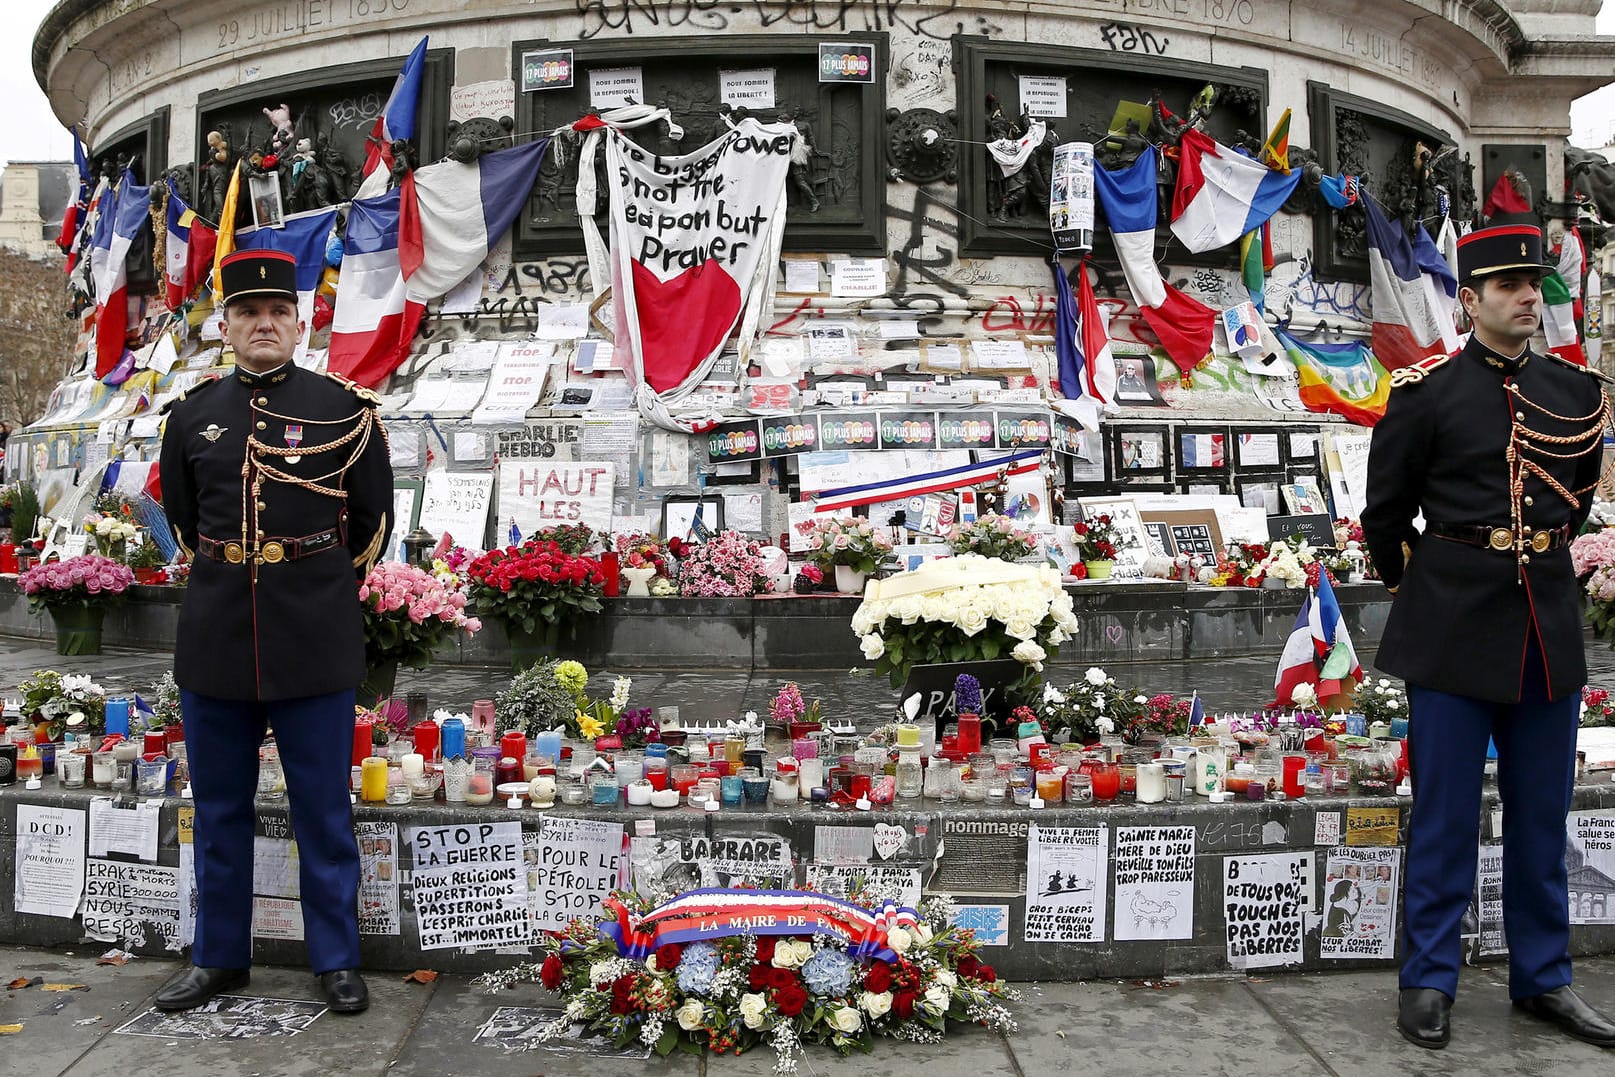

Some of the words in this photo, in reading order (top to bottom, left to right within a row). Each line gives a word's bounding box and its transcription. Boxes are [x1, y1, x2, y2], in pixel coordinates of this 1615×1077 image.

[217, 20, 239, 49] 29
[248, 0, 334, 40] JUILLET
[1341, 24, 1355, 52] 14
[1361, 32, 1418, 75] JUILLET
[526, 69, 533, 80] 17
[534, 67, 548, 78] PLUS
[549, 63, 569, 76] JAMAIS
[822, 60, 830, 70] 17
[831, 59, 847, 71] PLUS
[848, 59, 868, 71] JAMAIS
[744, 79, 769, 87] SOMMES
[633, 176, 687, 204] not
[689, 173, 726, 202] the
[624, 203, 711, 239] eapon
[716, 199, 768, 239] but
[511, 348, 541, 357] STOP
[712, 365, 732, 374] ARLIE
[503, 376, 533, 385] STOP
[499, 424, 580, 444] CHARLIE
[765, 434, 774, 445] 17
[775, 432, 791, 444] PLUS
[792, 428, 816, 442] JAMAIS
[823, 427, 832, 438] 17
[833, 427, 850, 439] PLUS
[851, 426, 875, 438] JAMAIS
[882, 426, 891, 437] 17
[892, 426, 909, 438] PLUS
[910, 425, 933, 438] JAMAIS
[941, 426, 950, 437] 17
[951, 426, 969, 438] PLUS
[968, 424, 992, 437] JAMAIS
[1000, 424, 1009, 436] 17
[1010, 425, 1027, 437] PLUS
[1027, 424, 1050, 437] JAMAIS
[499, 441, 556, 459] HEBDO
[708, 441, 718, 452] 17
[718, 437, 734, 450] PLUS
[735, 435, 757, 448] JAMAIS
[518, 467, 607, 497] HAUT
[539, 500, 582, 521] LES
[925, 687, 996, 718] PAX
[259, 815, 277, 825] VIVE
[277, 817, 287, 826] LA
[542, 819, 572, 829] IRAK
[1577, 817, 1589, 828] La
[1589, 817, 1615, 828] Franc
[264, 825, 279, 837] VIE
[416, 824, 494, 849] STOP
[1060, 828, 1070, 836] LA
[1073, 828, 1100, 837] FEMME
[1577, 829, 1603, 839] salue
[1603, 831, 1615, 839] se
[680, 839, 783, 863] BARBARE
[1149, 845, 1162, 856] DE
[1584, 839, 1612, 851] héros
[418, 851, 441, 866] LA
[446, 844, 516, 865] GUERRE
[542, 845, 589, 867] POUR
[599, 853, 619, 871] LE
[1328, 848, 1339, 858] NE
[1339, 847, 1350, 857] LES
[24, 854, 64, 865] POURQUOI
[1156, 858, 1175, 871] TON
[88, 863, 127, 880] IRAK
[837, 867, 868, 877] MORTS
[1116, 872, 1140, 886] TROP
[1141, 870, 1193, 884] PARESSEUX
[141, 875, 176, 887] MORTS
[130, 886, 153, 897] 300
[154, 890, 179, 899] 000
[1226, 884, 1240, 897] DE
[1240, 883, 1273, 902] TOUS
[545, 890, 601, 910] STOP
[86, 898, 135, 917] NOUS
[418, 898, 504, 918] PASSERONS
[1028, 905, 1054, 914] GROS
[1226, 900, 1300, 923] TOUCHEZ
[534, 910, 549, 921] LA
[1055, 915, 1095, 925] CERVEAU
[700, 920, 719, 932] LA
[728, 915, 777, 930] MAIRE
[787, 915, 807, 927] DE
[1026, 921, 1054, 931] MALE
[1056, 924, 1091, 933] MACHO
[1025, 930, 1041, 939] ON
[1043, 931, 1056, 940] SE
[1227, 922, 1261, 942] PAS
[1267, 920, 1301, 937] NOS
[1321, 937, 1344, 946] LEUR
[1321, 944, 1337, 952] NOS
